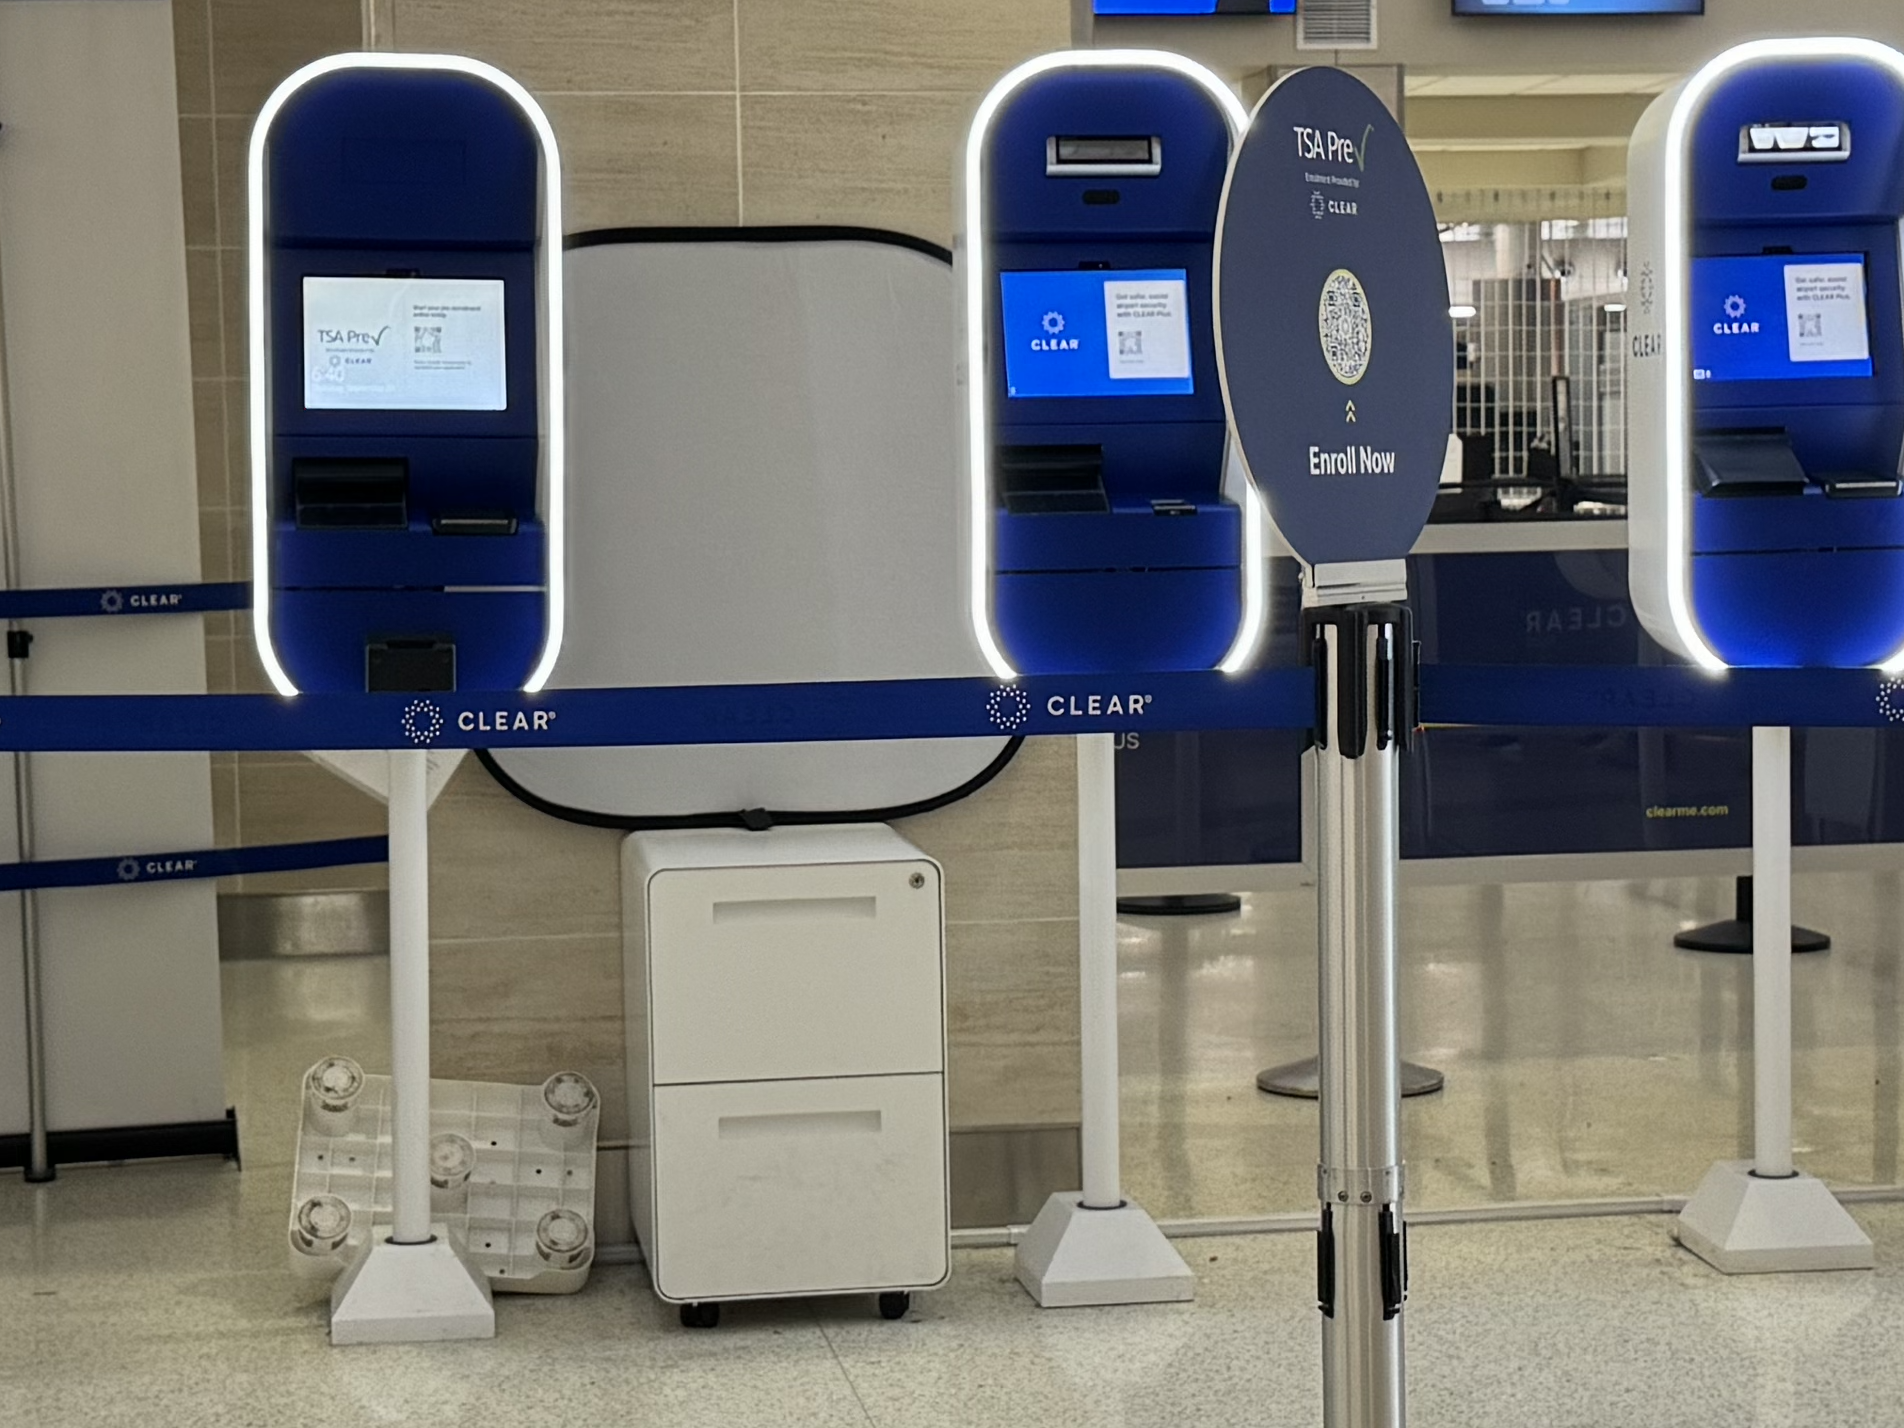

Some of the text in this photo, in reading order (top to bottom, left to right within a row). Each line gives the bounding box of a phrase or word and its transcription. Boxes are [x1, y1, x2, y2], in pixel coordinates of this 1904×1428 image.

[1293, 126, 1325, 160] TSA
[1328, 200, 1357, 215] CLEAR
[317, 329, 344, 343] TSA
[1713, 322, 1760, 335] CLEAR
[1030, 338, 1079, 351] CLEAR
[1309, 445, 1395, 476] Enroll Now
[130, 593, 179, 608] CLEAR
[1645, 802, 1729, 819] clearme.com
